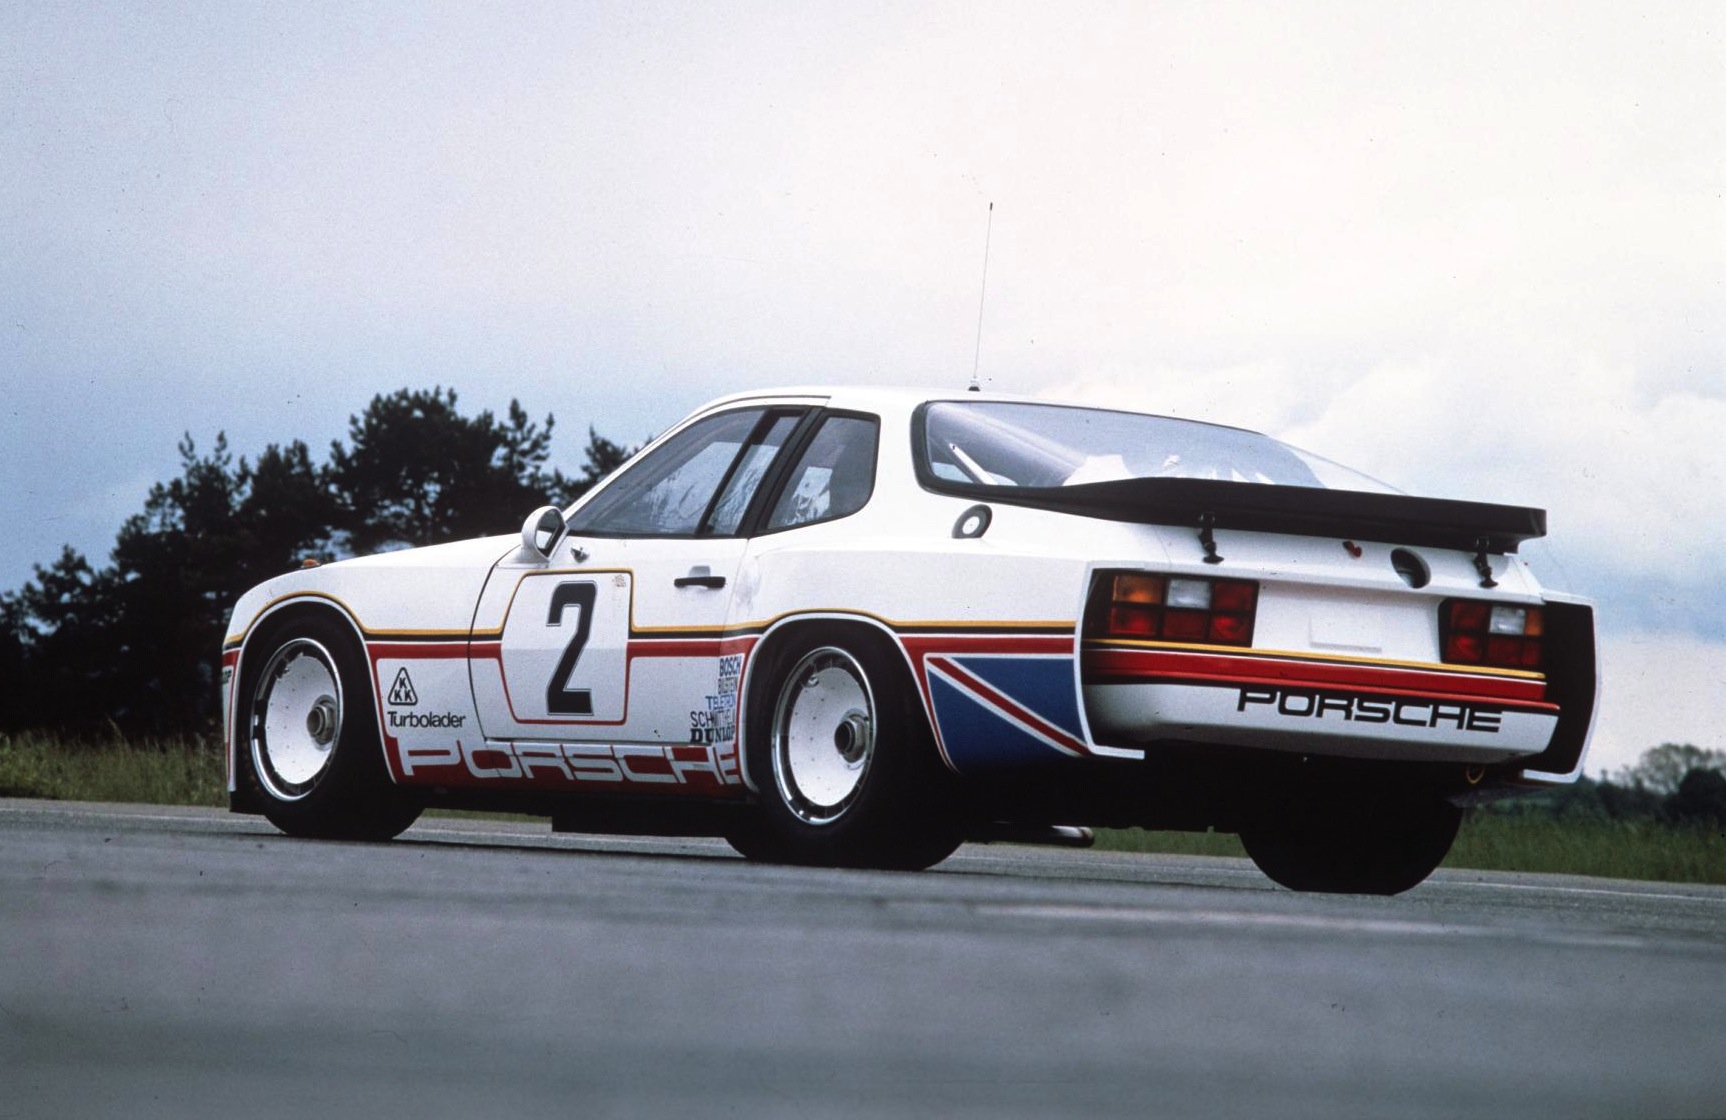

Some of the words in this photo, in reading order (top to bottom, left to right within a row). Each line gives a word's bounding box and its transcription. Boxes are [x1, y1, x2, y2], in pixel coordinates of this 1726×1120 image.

[546, 581, 597, 715] 2
[719, 657, 741, 677] BOSCH
[387, 711, 466, 728] Turbolader
[1237, 688, 1502, 732] PORSCHE
[690, 726, 735, 744] DUNLOP
[398, 738, 740, 784] PORSCHE
